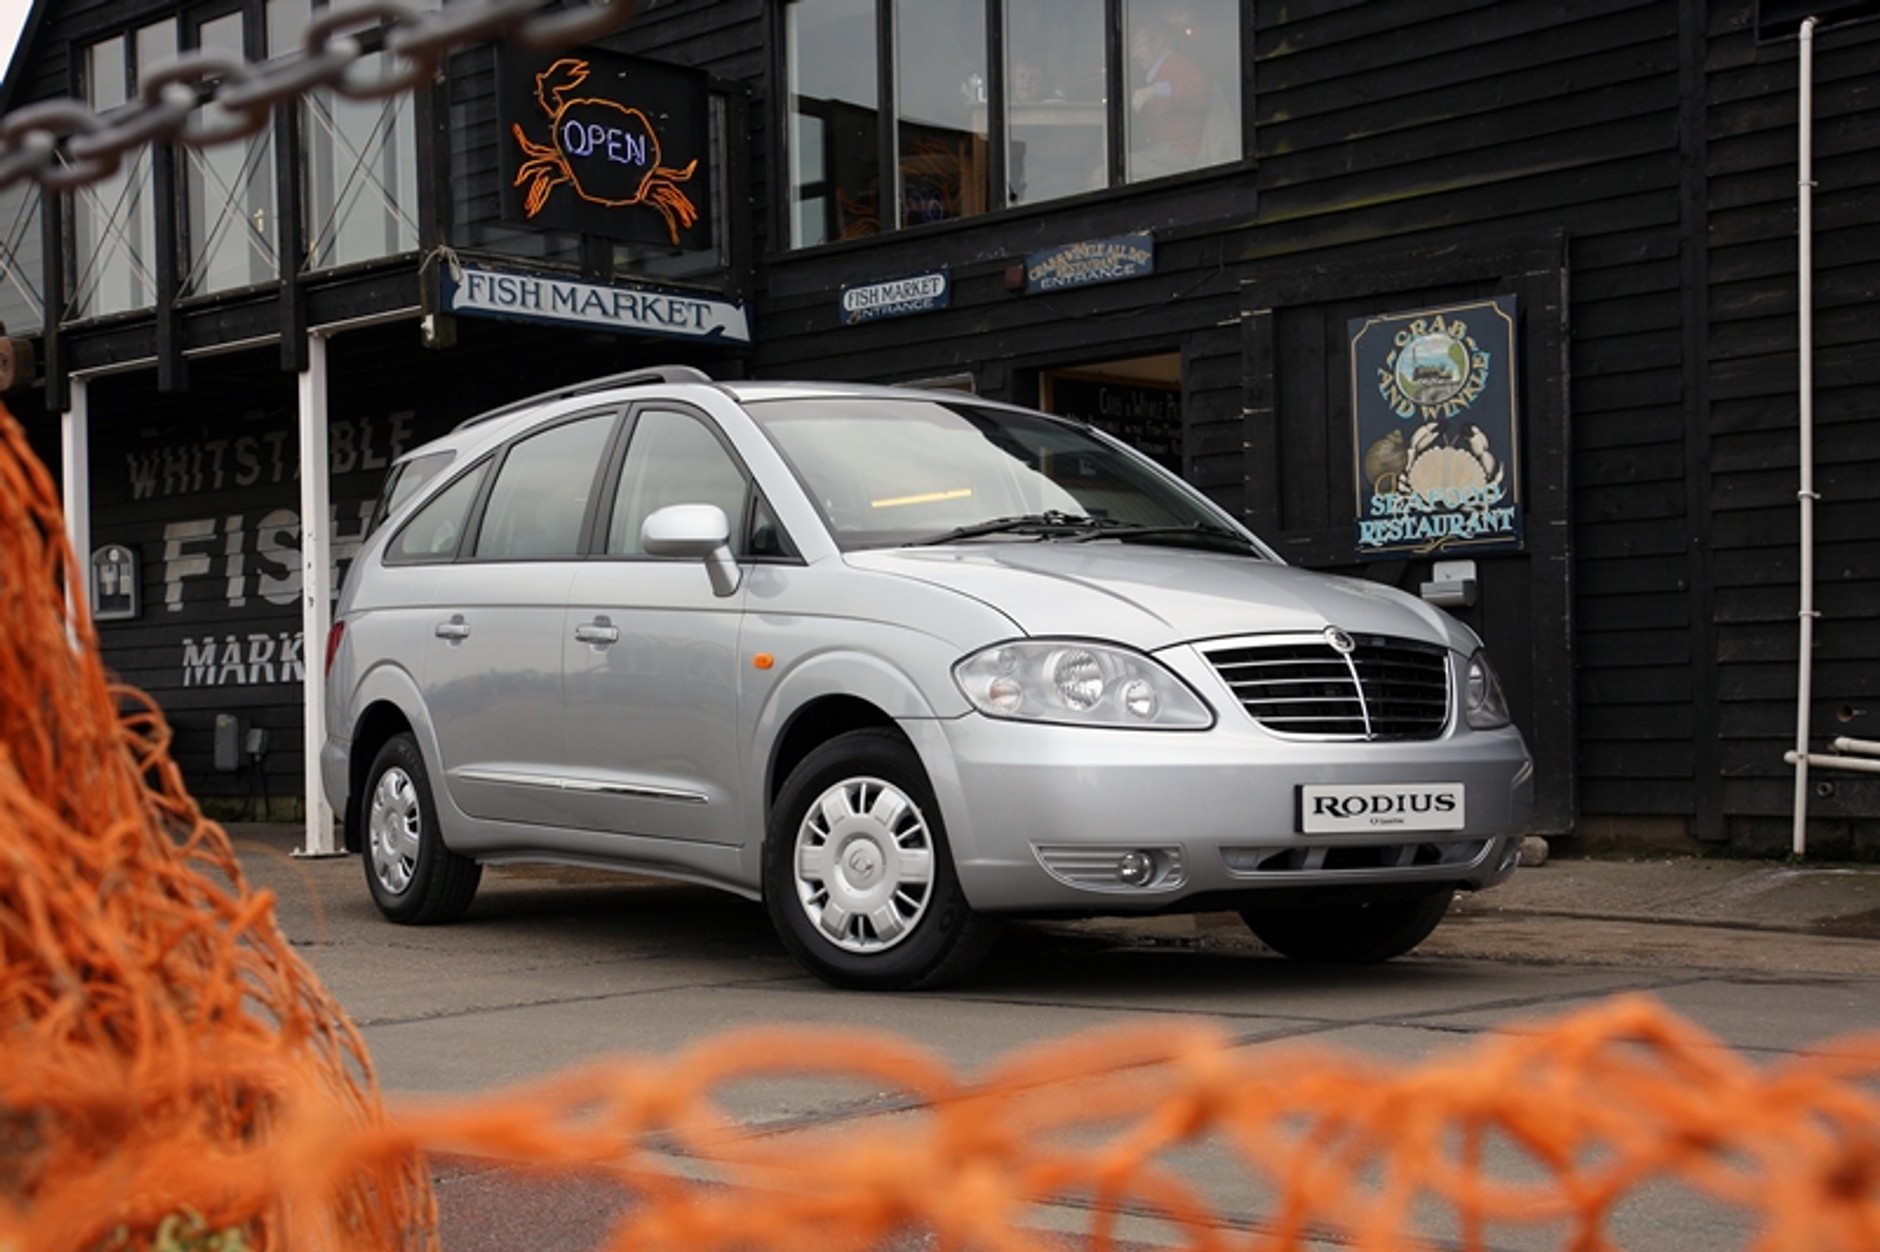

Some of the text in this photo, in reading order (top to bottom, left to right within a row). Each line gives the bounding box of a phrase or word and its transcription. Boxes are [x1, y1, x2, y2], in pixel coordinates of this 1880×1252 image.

[563, 120, 645, 165] OPEN
[1041, 263, 1136, 289] ENTRANCE
[467, 273, 711, 329] FISH MARKET
[848, 277, 941, 309] FISH MARKET
[851, 298, 934, 320] NTRANCE
[1394, 314, 1467, 347] CRAB
[1377, 367, 1416, 419] AND
[126, 409, 416, 500] WHITSTBLE
[1370, 484, 1502, 517] SEAFOOD
[1358, 506, 1516, 547] RESTAURANT
[1312, 793, 1456, 819] RODIUS
